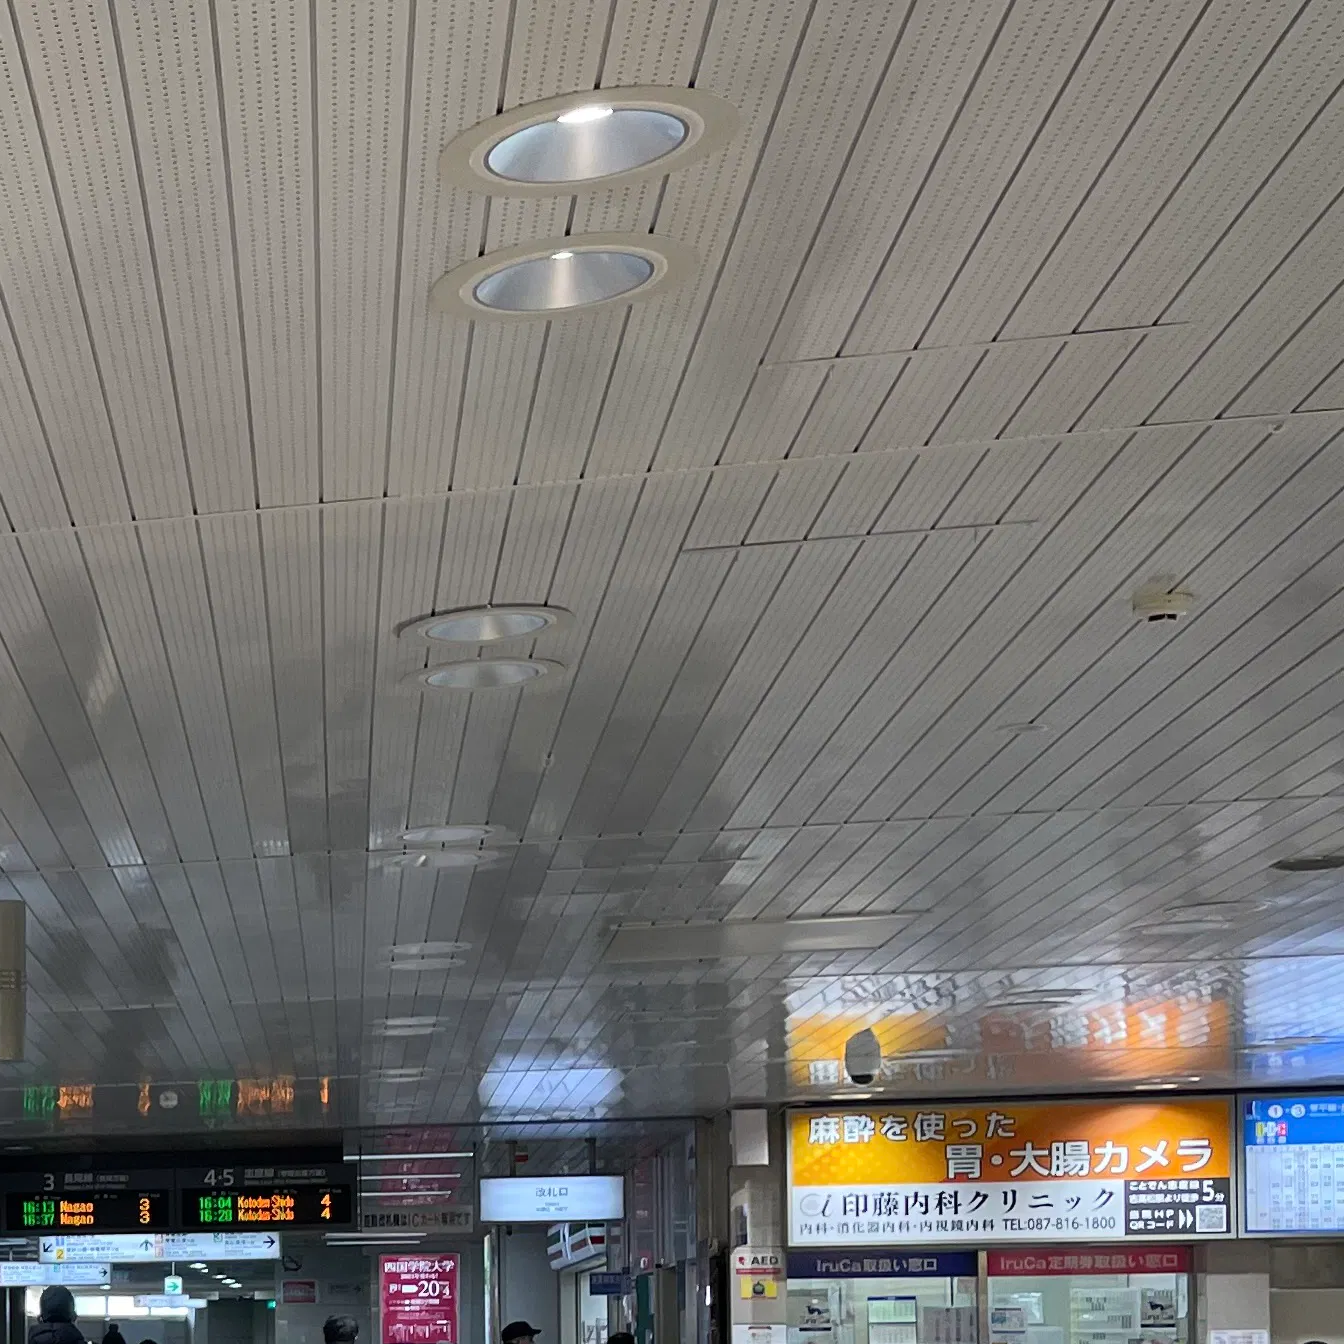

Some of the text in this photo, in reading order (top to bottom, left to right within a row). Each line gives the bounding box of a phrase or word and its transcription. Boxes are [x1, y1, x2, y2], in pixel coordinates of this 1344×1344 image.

[808, 1111, 1015, 1145] 麻酔を使った
[945, 1137, 1212, 1180] 胃・大腸カメラ
[43, 1174, 55, 1191] 3
[536, 1187, 568, 1197] 改札口
[139, 1198, 150, 1211] 3
[320, 1194, 332, 1206] 4
[842, 1186, 1115, 1218] 印藤内科クリニック
[60, 1201, 94, 1214] Nagao
[320, 1207, 331, 1219] 4
[60, 1213, 94, 1226] Nagao
[139, 1211, 150, 1224] 3
[750, 1256, 779, 1266] AED
